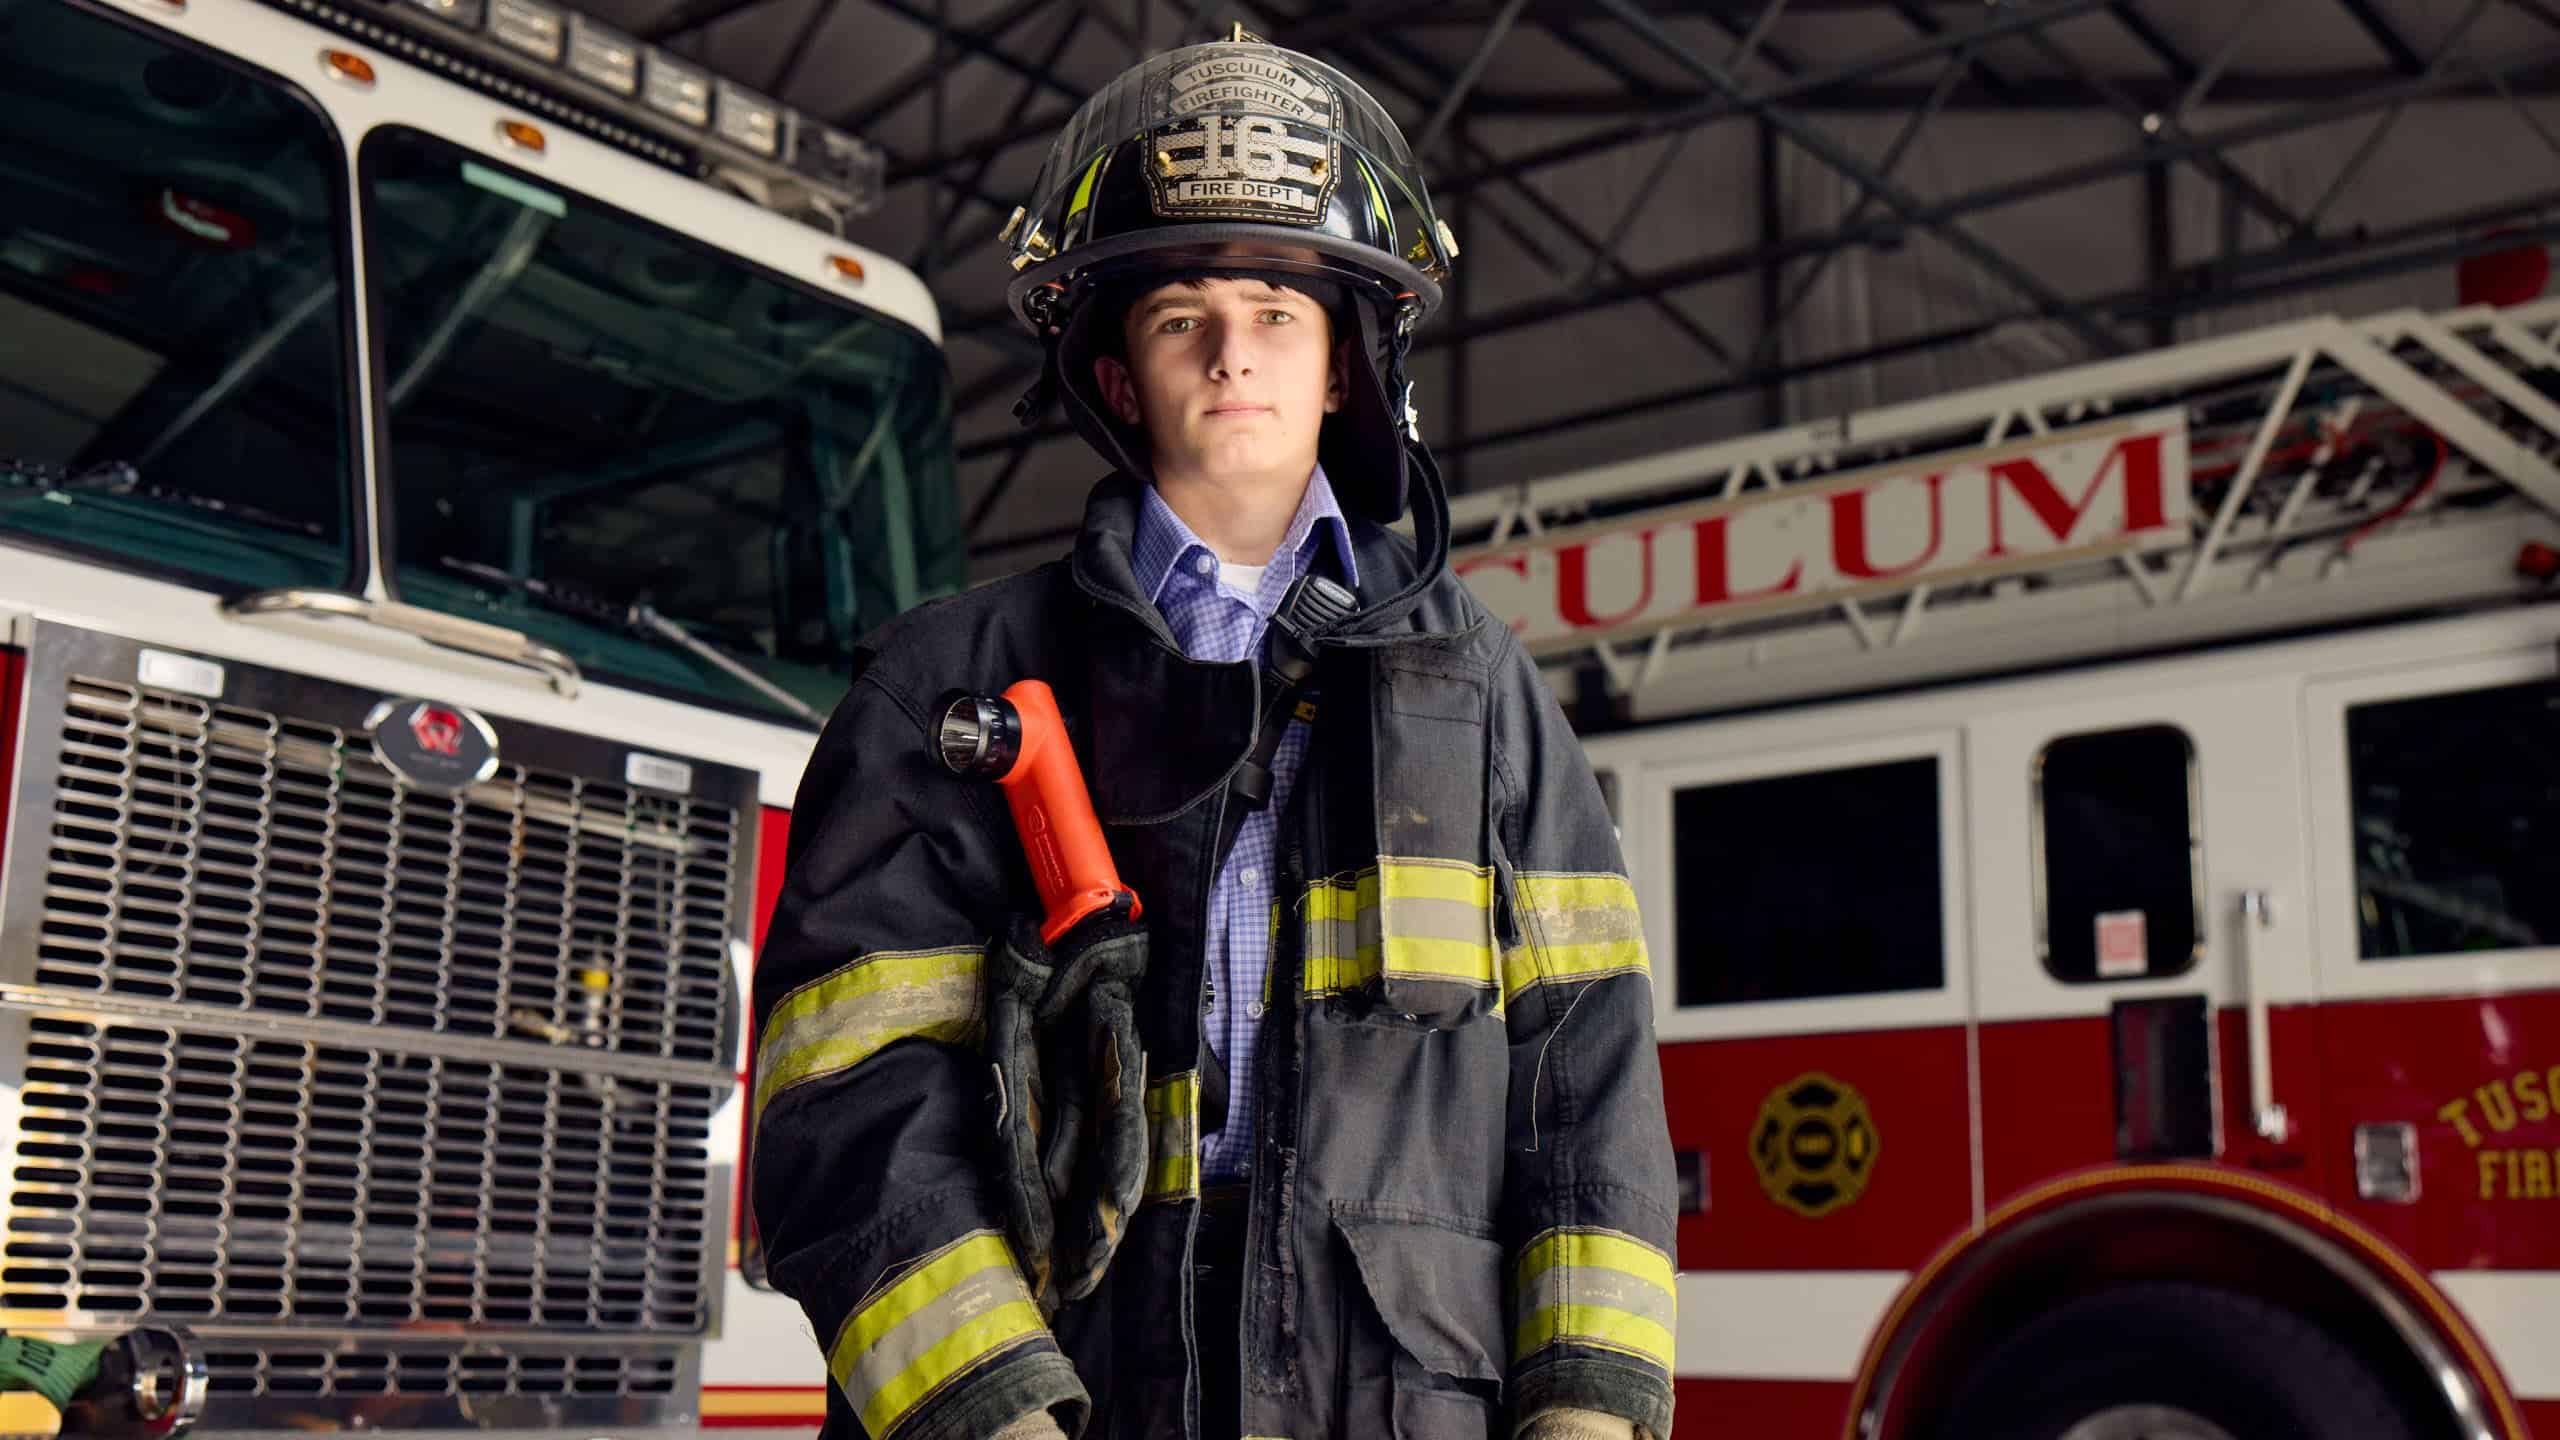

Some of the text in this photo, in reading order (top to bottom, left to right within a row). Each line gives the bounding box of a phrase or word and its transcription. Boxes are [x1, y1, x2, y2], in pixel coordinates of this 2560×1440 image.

[1185, 61, 1297, 89] TUSCULUM
[1180, 85, 1305, 116] FIREFIGHTER
[1197, 114, 1288, 182] 16
[1190, 182, 1294, 200] FIRE DEPT
[2477, 1148, 2560, 1199] FIR
